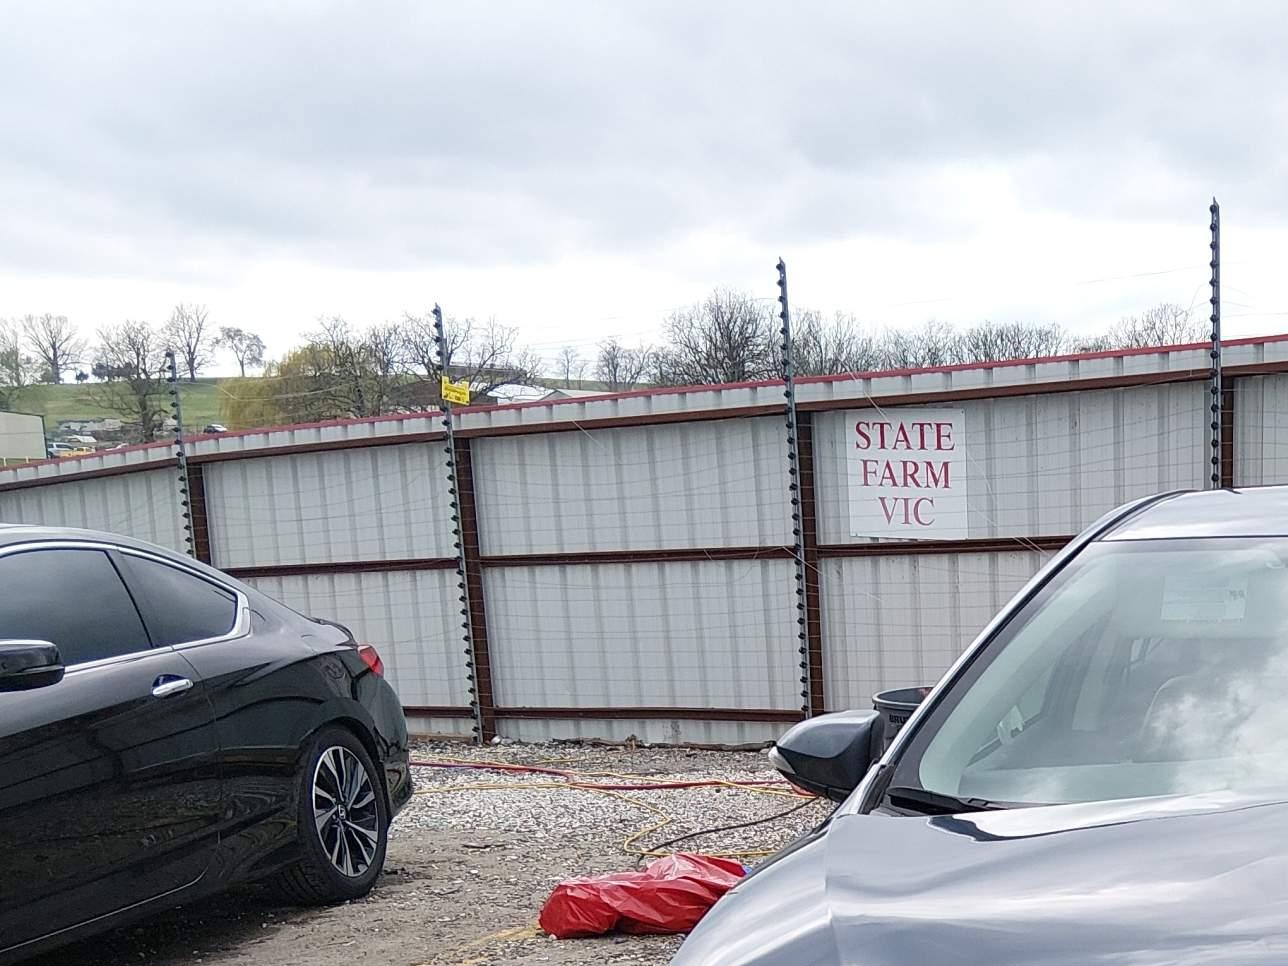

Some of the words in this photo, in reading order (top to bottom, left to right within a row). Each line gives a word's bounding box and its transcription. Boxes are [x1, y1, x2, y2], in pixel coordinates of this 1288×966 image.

[855, 421, 955, 451] STATE
[860, 459, 952, 489] FARM
[878, 496, 936, 527] VIC
